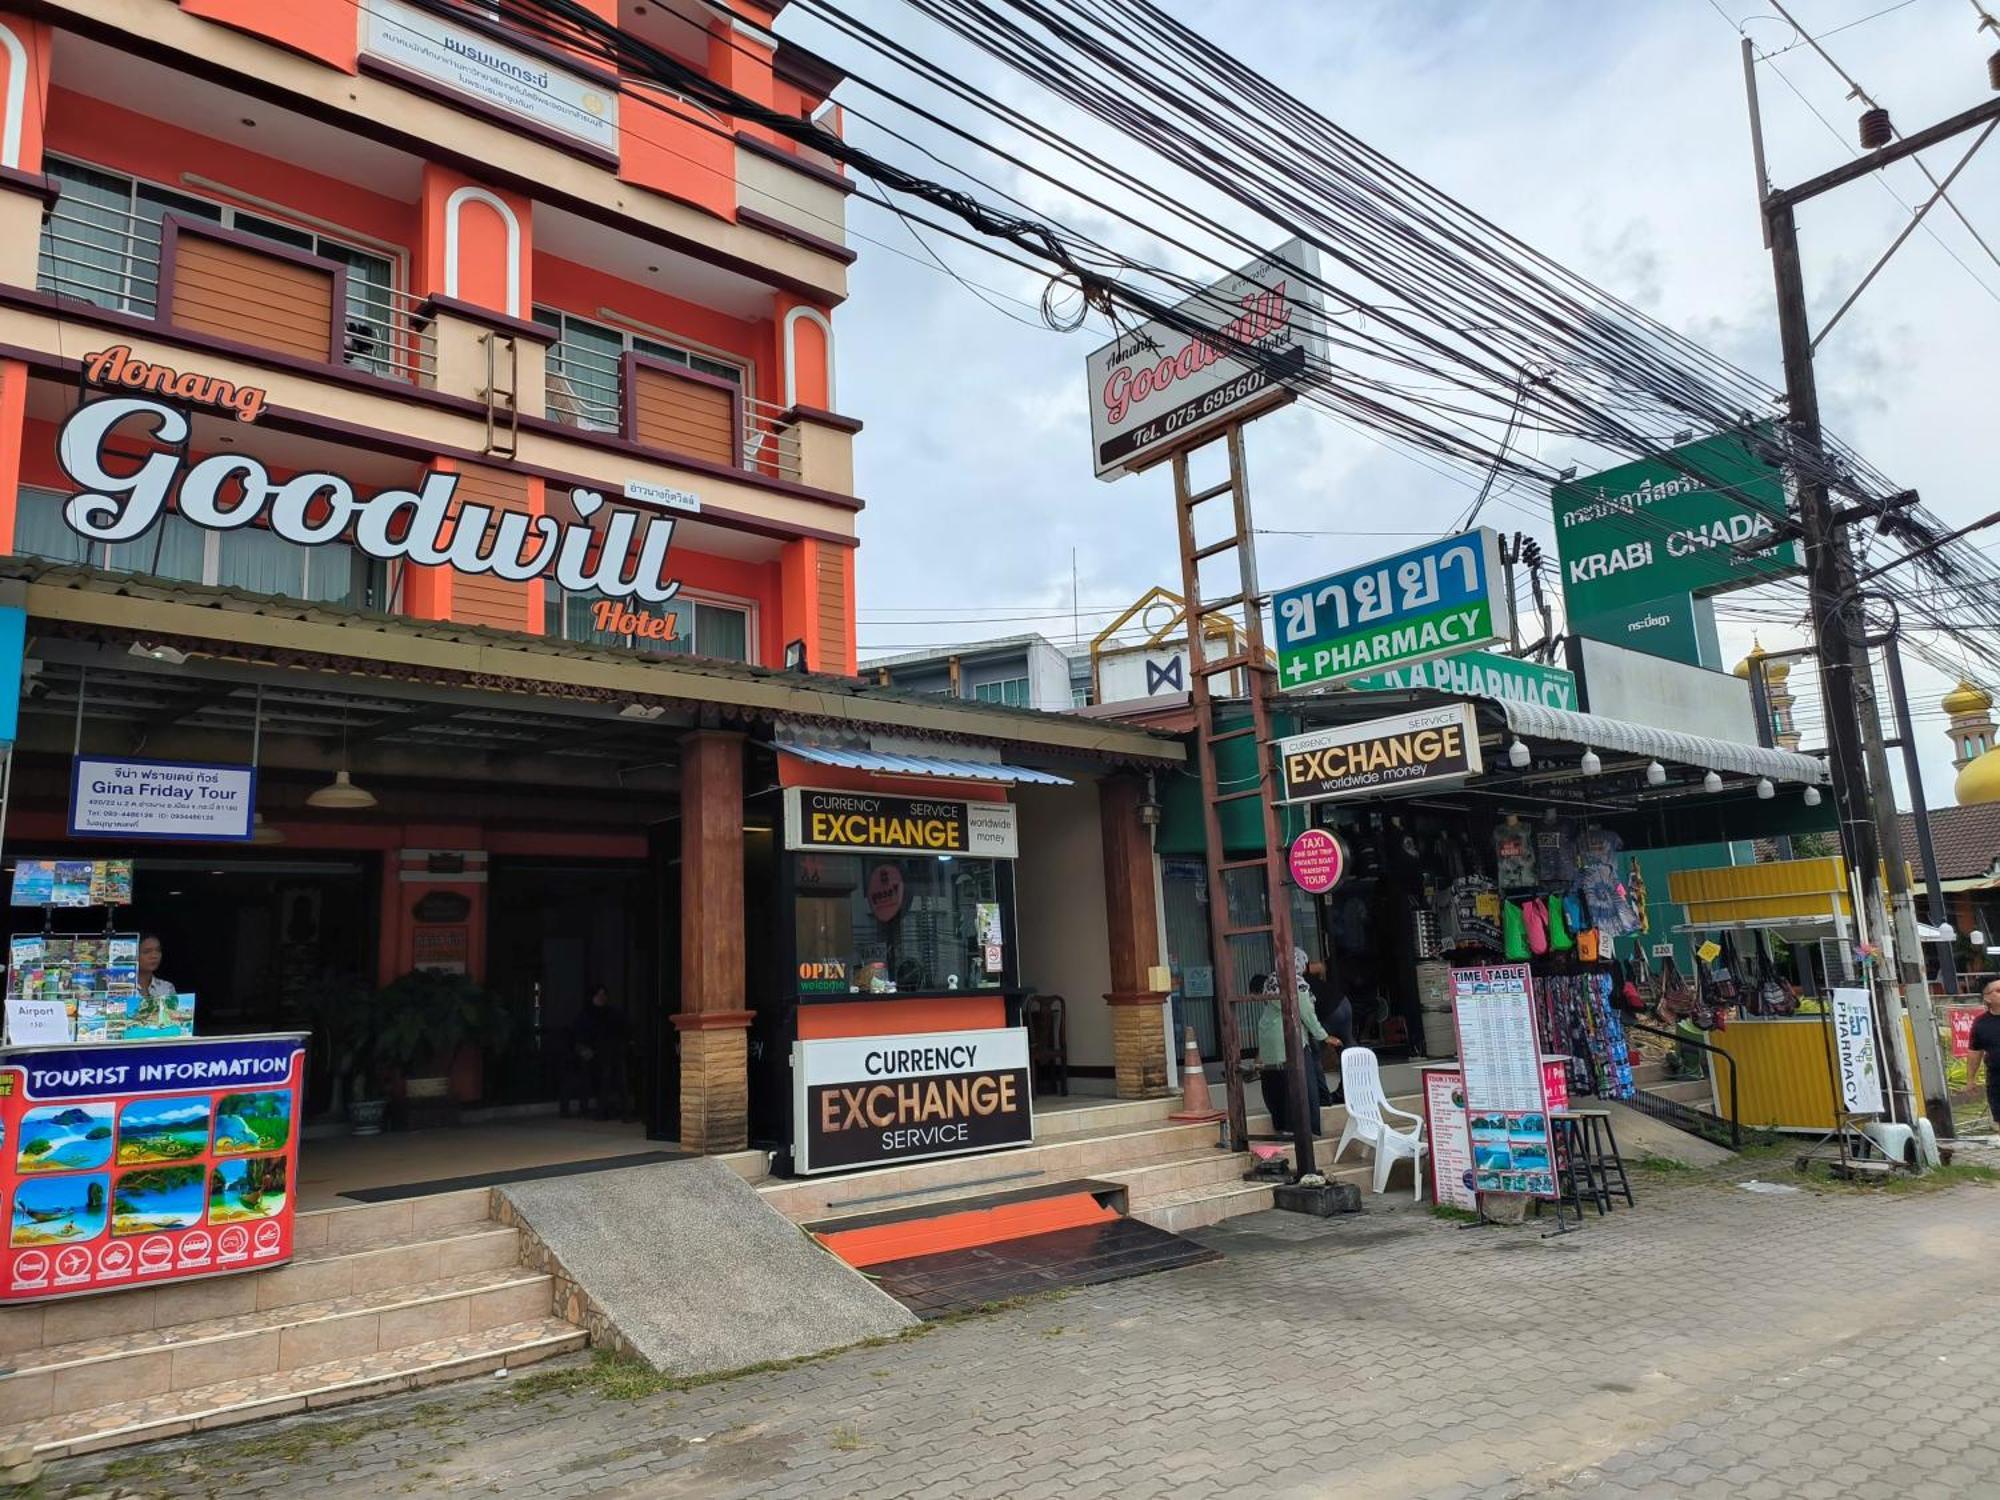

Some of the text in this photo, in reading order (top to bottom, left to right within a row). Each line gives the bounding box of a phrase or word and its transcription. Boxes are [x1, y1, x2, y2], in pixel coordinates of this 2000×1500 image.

[82, 343, 267, 423] Aonang
[1132, 428, 1161, 447] Tel.
[54, 396, 683, 605] Goodwill
[1568, 511, 1776, 584] KRABI CHADA
[1280, 545, 1480, 644] ขายยา
[590, 599, 680, 642] Hotel
[1313, 608, 1481, 677] PHARMACY
[1432, 658, 1570, 711] PHARMACY
[1407, 713, 1455, 730] SERVICE
[1288, 735, 1333, 753] CURRENCY
[1289, 726, 1462, 784] EXCHANGE
[92, 780, 237, 801] Gina Friday Tour
[1321, 763, 1428, 791] worldwide money
[811, 795, 959, 819] CURRENCY SERVICE
[811, 812, 961, 849] EXCHANGE
[968, 817, 1012, 830] worldwide
[976, 831, 1006, 845] money
[1300, 837, 1325, 849] TAXI
[1303, 875, 1328, 885] TOUR
[799, 962, 846, 980] OPEN
[1451, 968, 1526, 982] TIME TABLE
[18, 1006, 54, 1018] Airport
[864, 1045, 978, 1075] CURRENCY
[1837, 1001, 1858, 1107] PHARMACY
[31, 1065, 130, 1089] TOURIST
[138, 1057, 288, 1083] INFORMATION
[820, 1073, 1018, 1133] EXCHANGE
[881, 1123, 969, 1151] SERVICE
